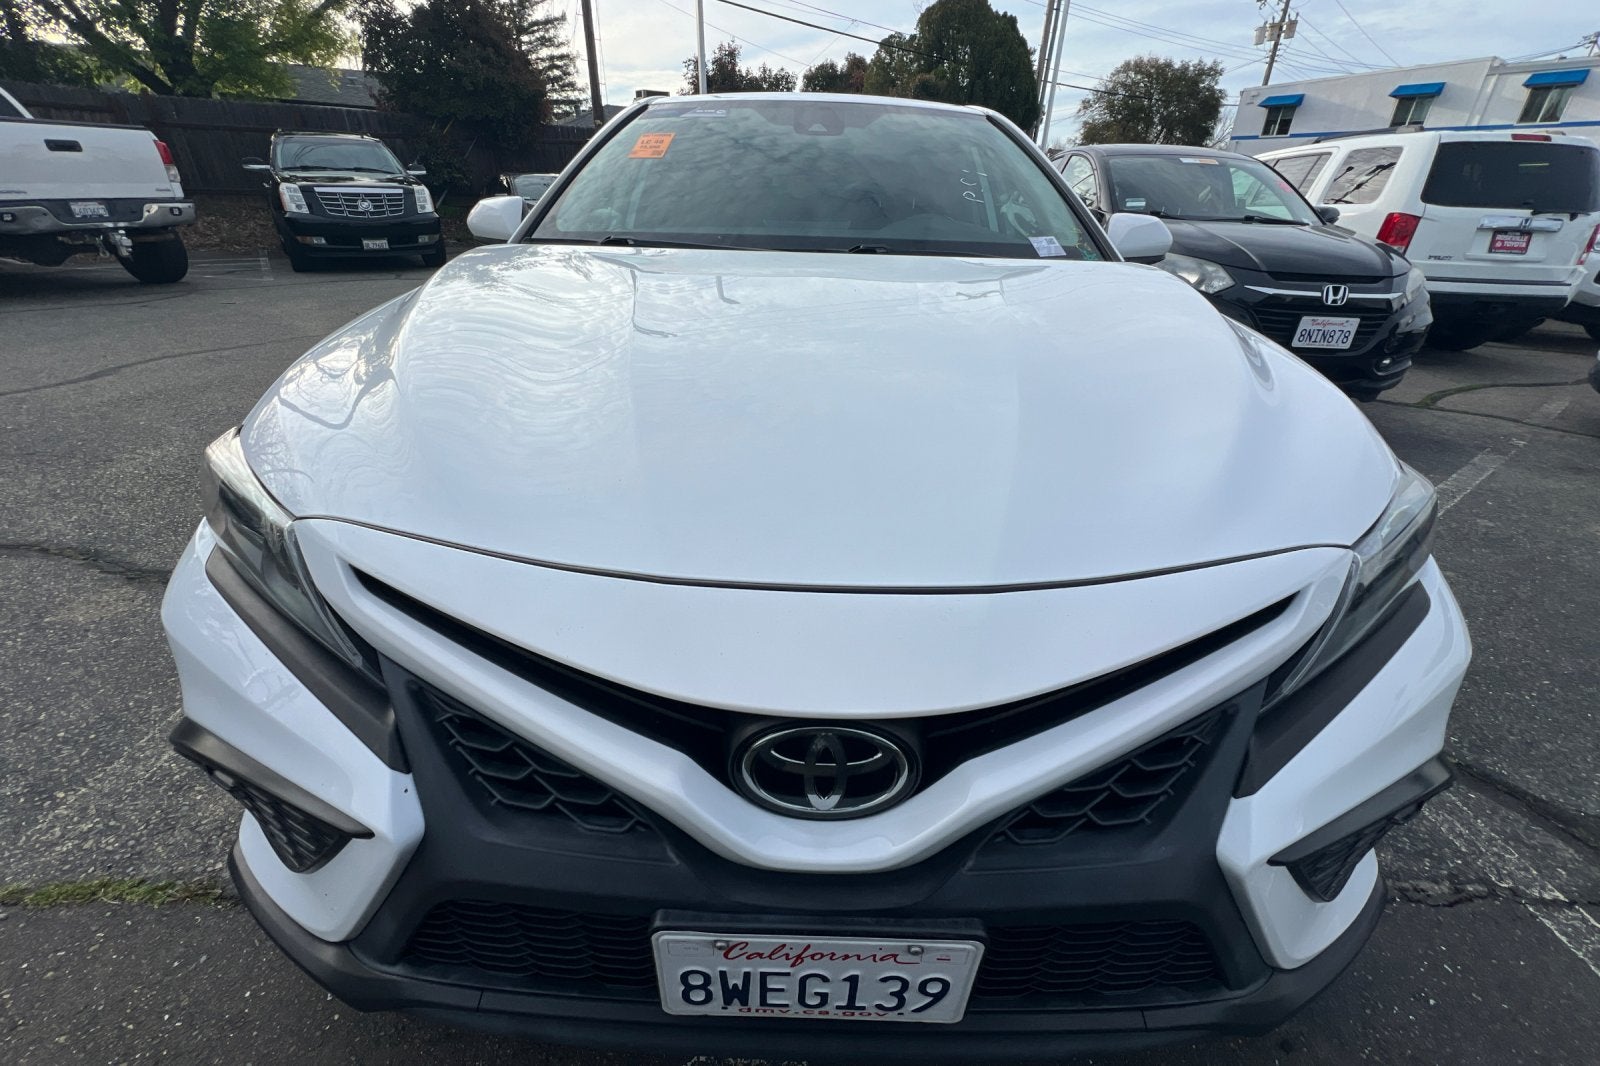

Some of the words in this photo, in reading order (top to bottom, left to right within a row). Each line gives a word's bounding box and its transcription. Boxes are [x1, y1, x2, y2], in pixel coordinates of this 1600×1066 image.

[1495, 234, 1529, 242] ROSEVILLE
[1311, 319, 1347, 328] California
[1297, 328, 1351, 344] 8NIN878
[723, 941, 921, 968] California
[679, 969, 951, 1013] 8WEG139
[738, 1006, 888, 1017] dmv.ca.gov
